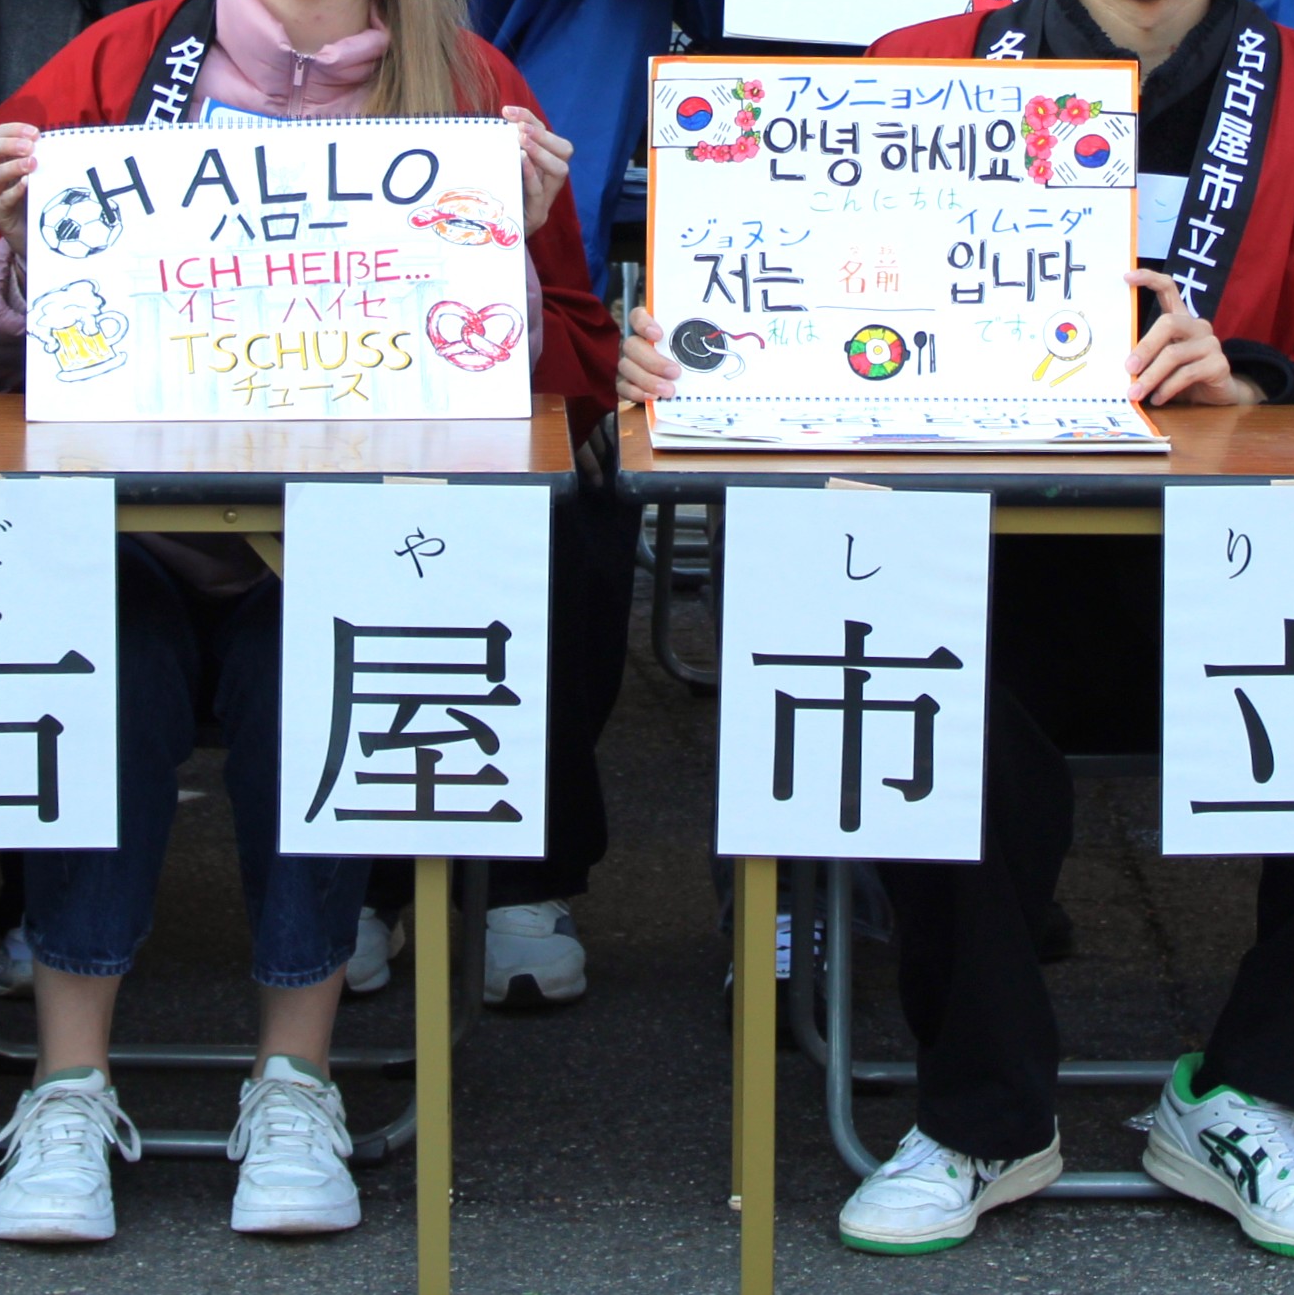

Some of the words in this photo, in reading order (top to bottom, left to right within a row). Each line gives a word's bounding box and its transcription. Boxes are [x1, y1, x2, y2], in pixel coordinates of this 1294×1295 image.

[86, 142, 440, 225] HALLO
[809, 187, 963, 213] こんにちは
[209, 213, 349, 242] ハロー
[159, 255, 243, 292] ICH
[693, 252, 809, 312] 저는
[838, 259, 899, 294] 名前
[947, 239, 1086, 304] 입니다
[170, 329, 413, 374] TSCHÜSS
[767, 318, 821, 345] 私は
[393, 527, 446, 579] や
[843, 532, 882, 581] し
[305, 616, 524, 823] 屋
[752, 618, 964, 833] 市
